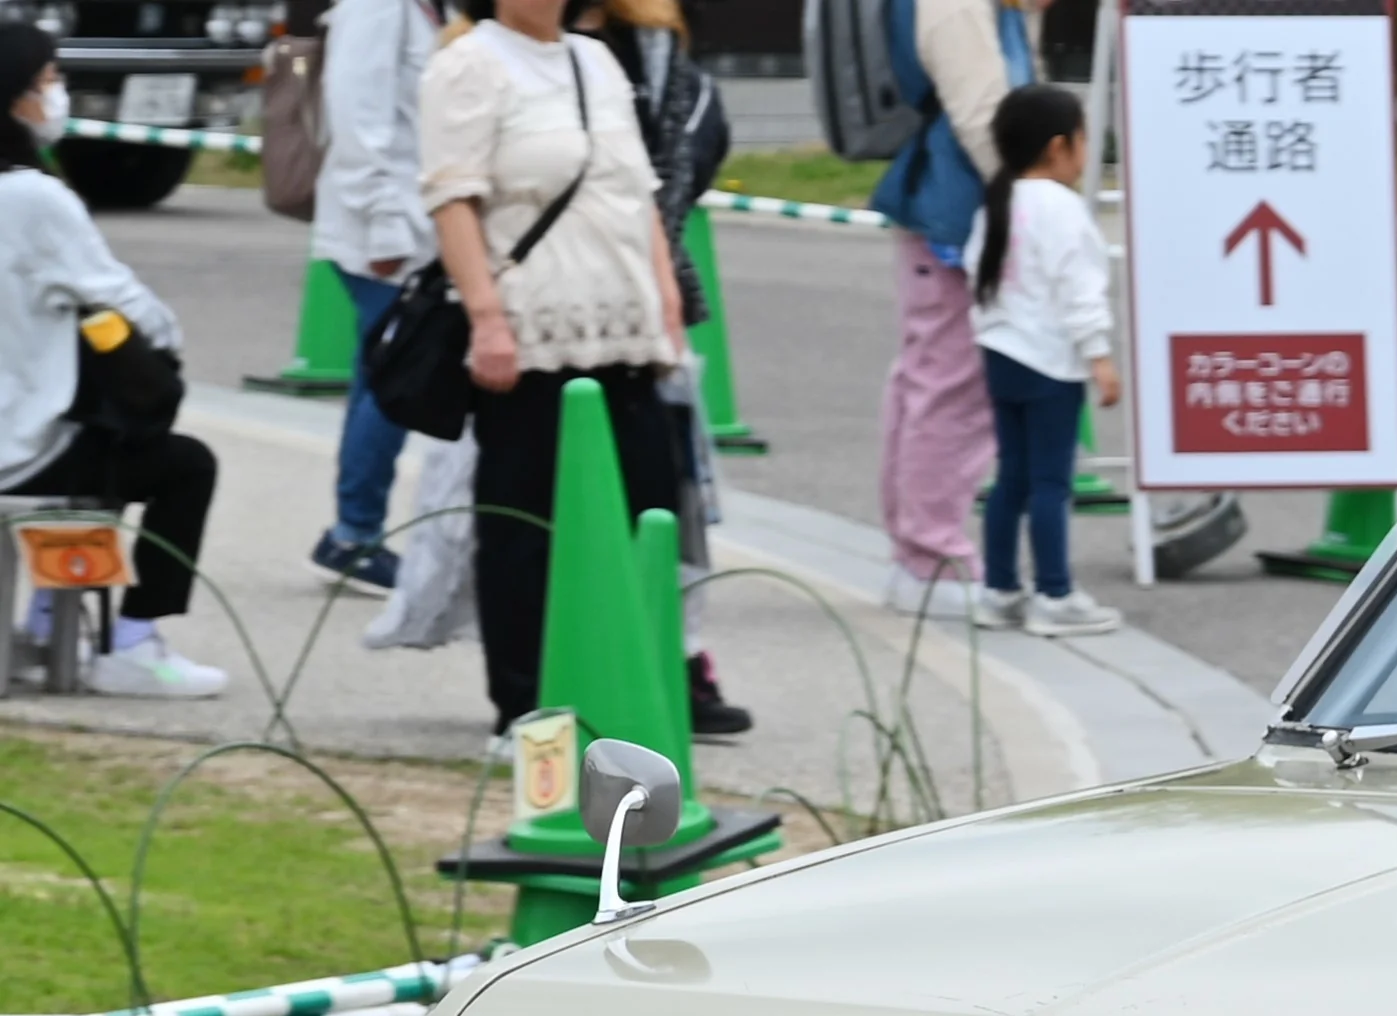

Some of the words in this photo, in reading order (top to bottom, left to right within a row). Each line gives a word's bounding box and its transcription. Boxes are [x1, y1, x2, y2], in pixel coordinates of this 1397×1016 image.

[1173, 50, 1344, 104] 歩行者
[1205, 121, 1317, 173] 通路
